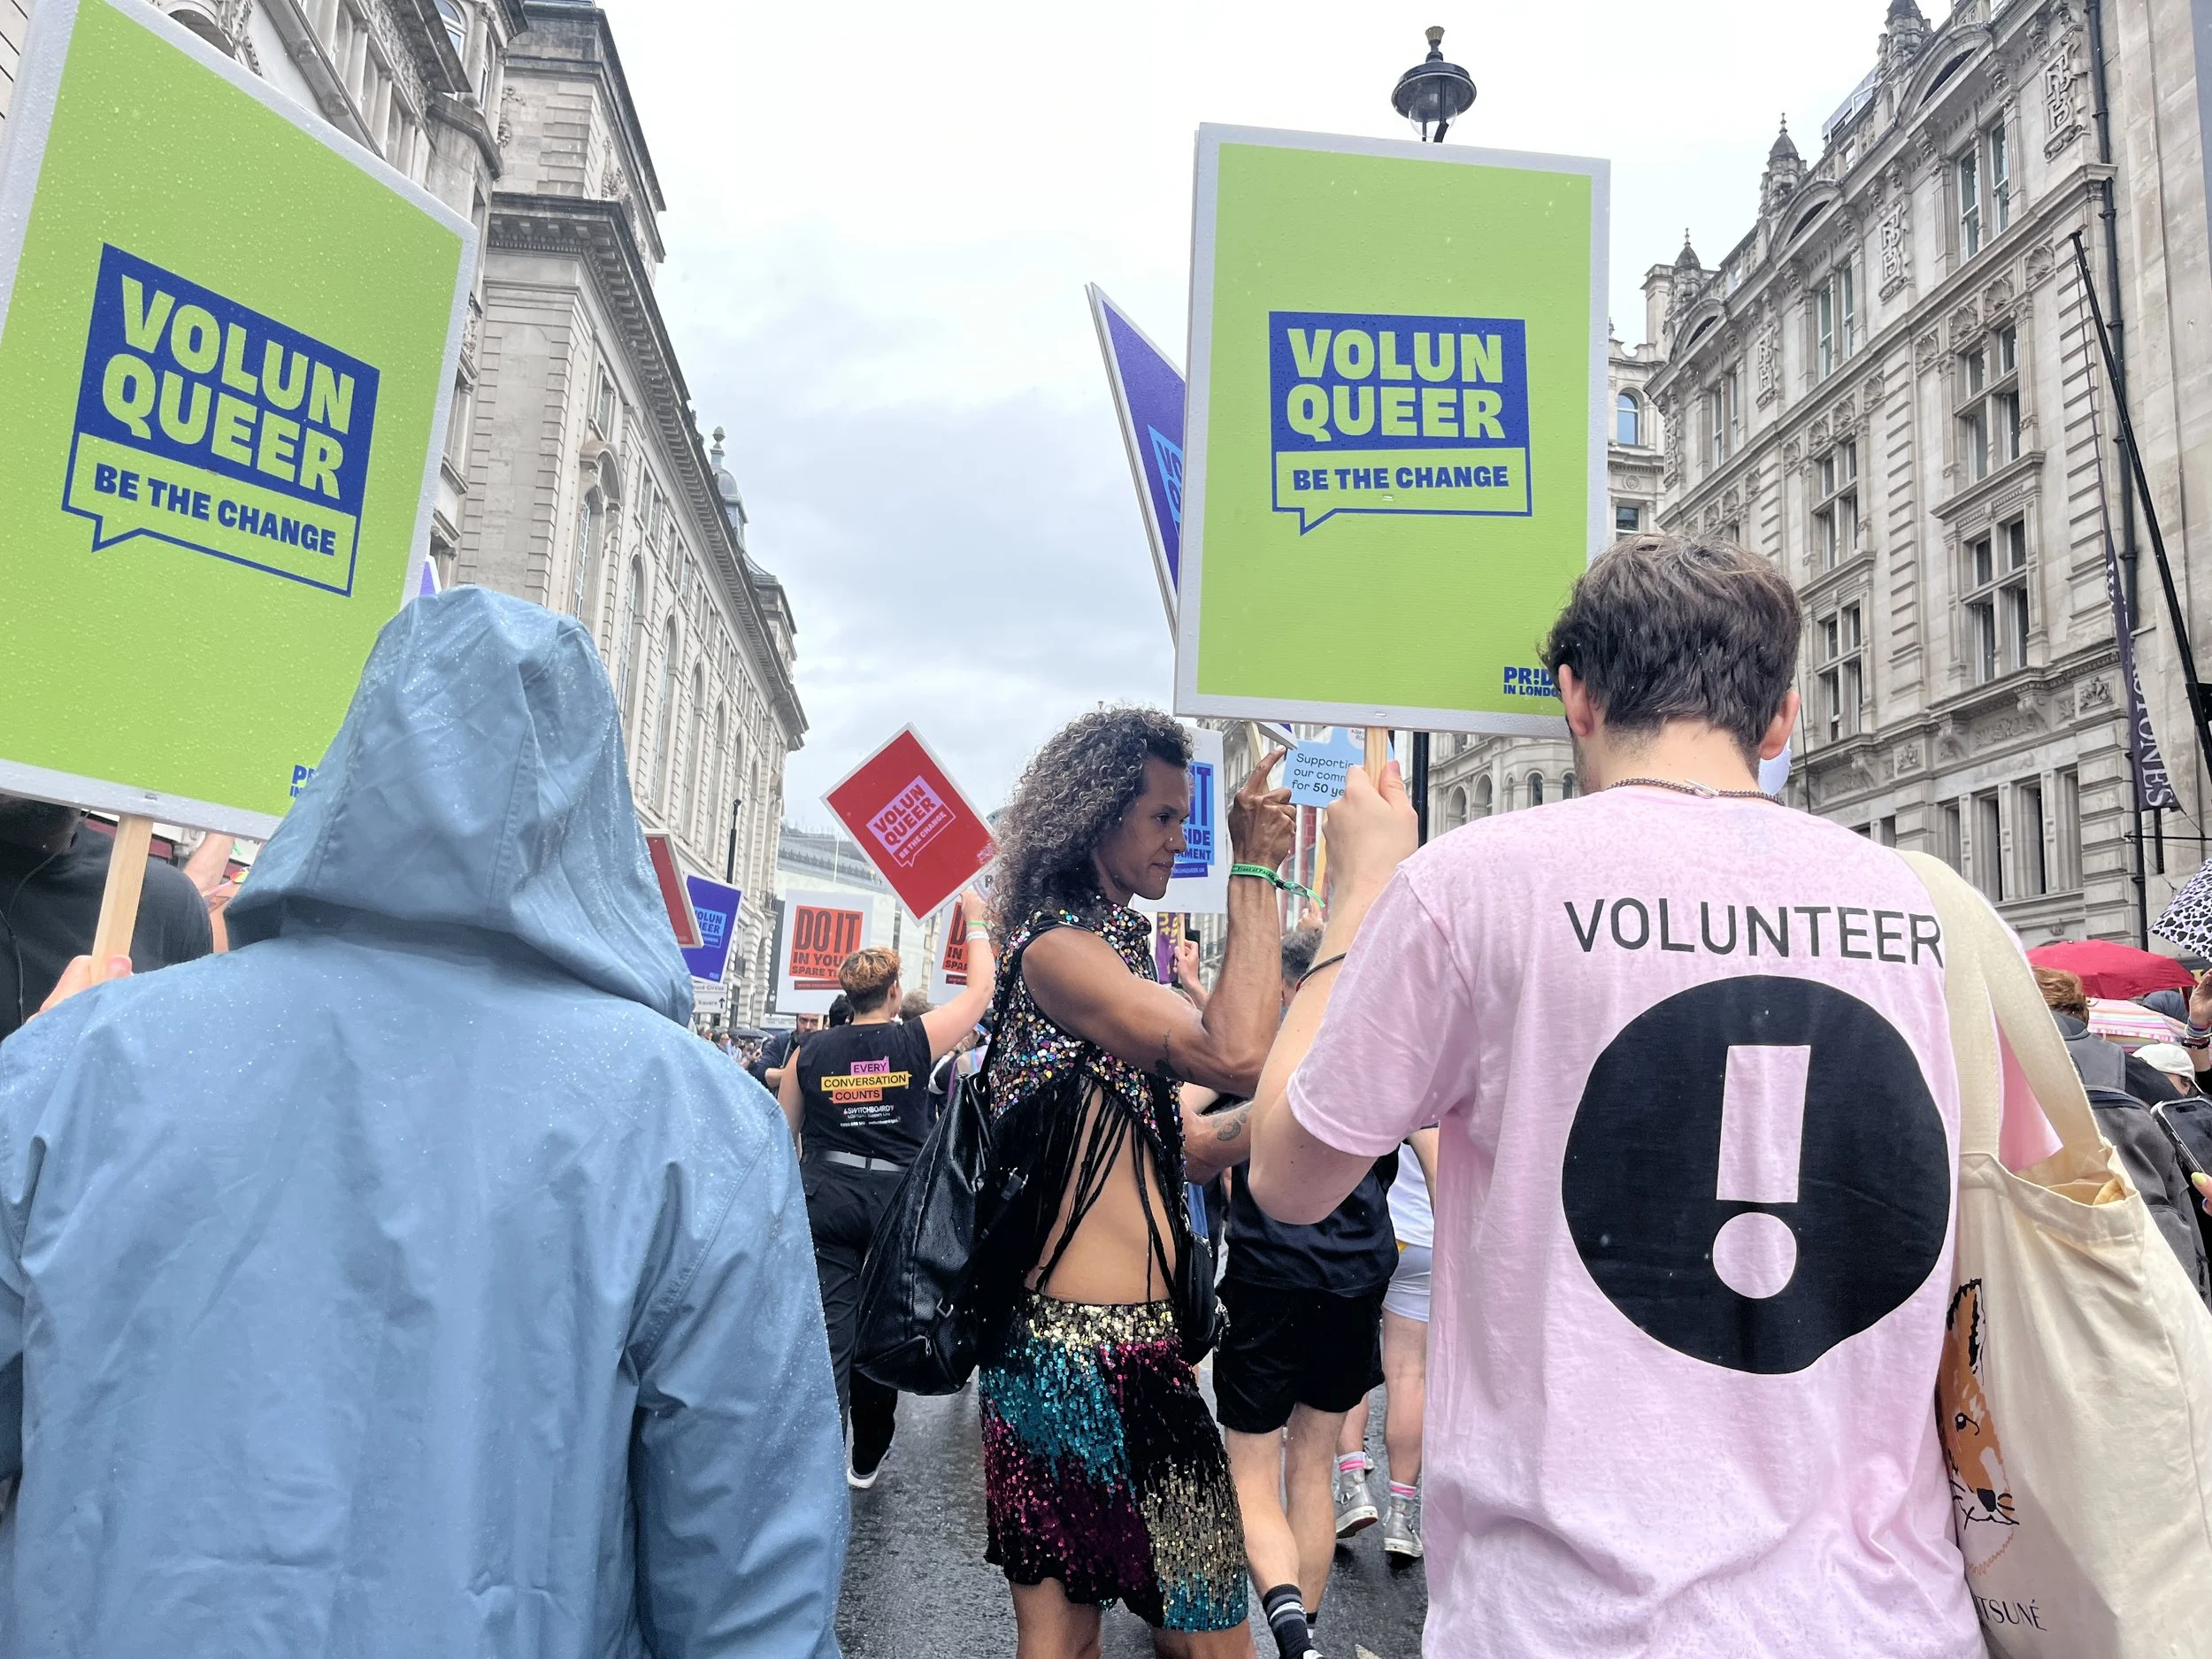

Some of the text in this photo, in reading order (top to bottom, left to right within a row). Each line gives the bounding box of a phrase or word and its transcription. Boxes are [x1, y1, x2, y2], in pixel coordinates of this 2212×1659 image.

[120, 273, 356, 435] VOLUN
[1286, 327, 1503, 384] VOLUN
[1286, 383, 1507, 442] QUEER
[101, 352, 345, 501] QUEER
[1293, 465, 1509, 492] BE THE CHANGE
[93, 462, 337, 557] BE THE CHANGE
[1503, 666, 1554, 686] PR!D
[1503, 685, 1557, 697] IN LONDO
[1294, 768, 1314, 777] our
[1292, 780, 1345, 798] for 50 ye
[872, 783, 926, 833] VOLUN
[884, 796, 937, 847] QUEER
[907, 835, 923, 849] THE
[919, 810, 948, 839] CHANGE
[795, 908, 860, 954] DO IT
[1563, 897, 1945, 968] VOLUNTEER
[793, 951, 844, 968] IN YOU
[947, 946, 964, 960] IN
[792, 965, 826, 976] SPARE
[853, 1062, 887, 1073] EVERY
[824, 1073, 907, 1088] CONVERSATION
[834, 1089, 880, 1101] COUNTS
[847, 1105, 891, 1114] SWITCHBOARD
